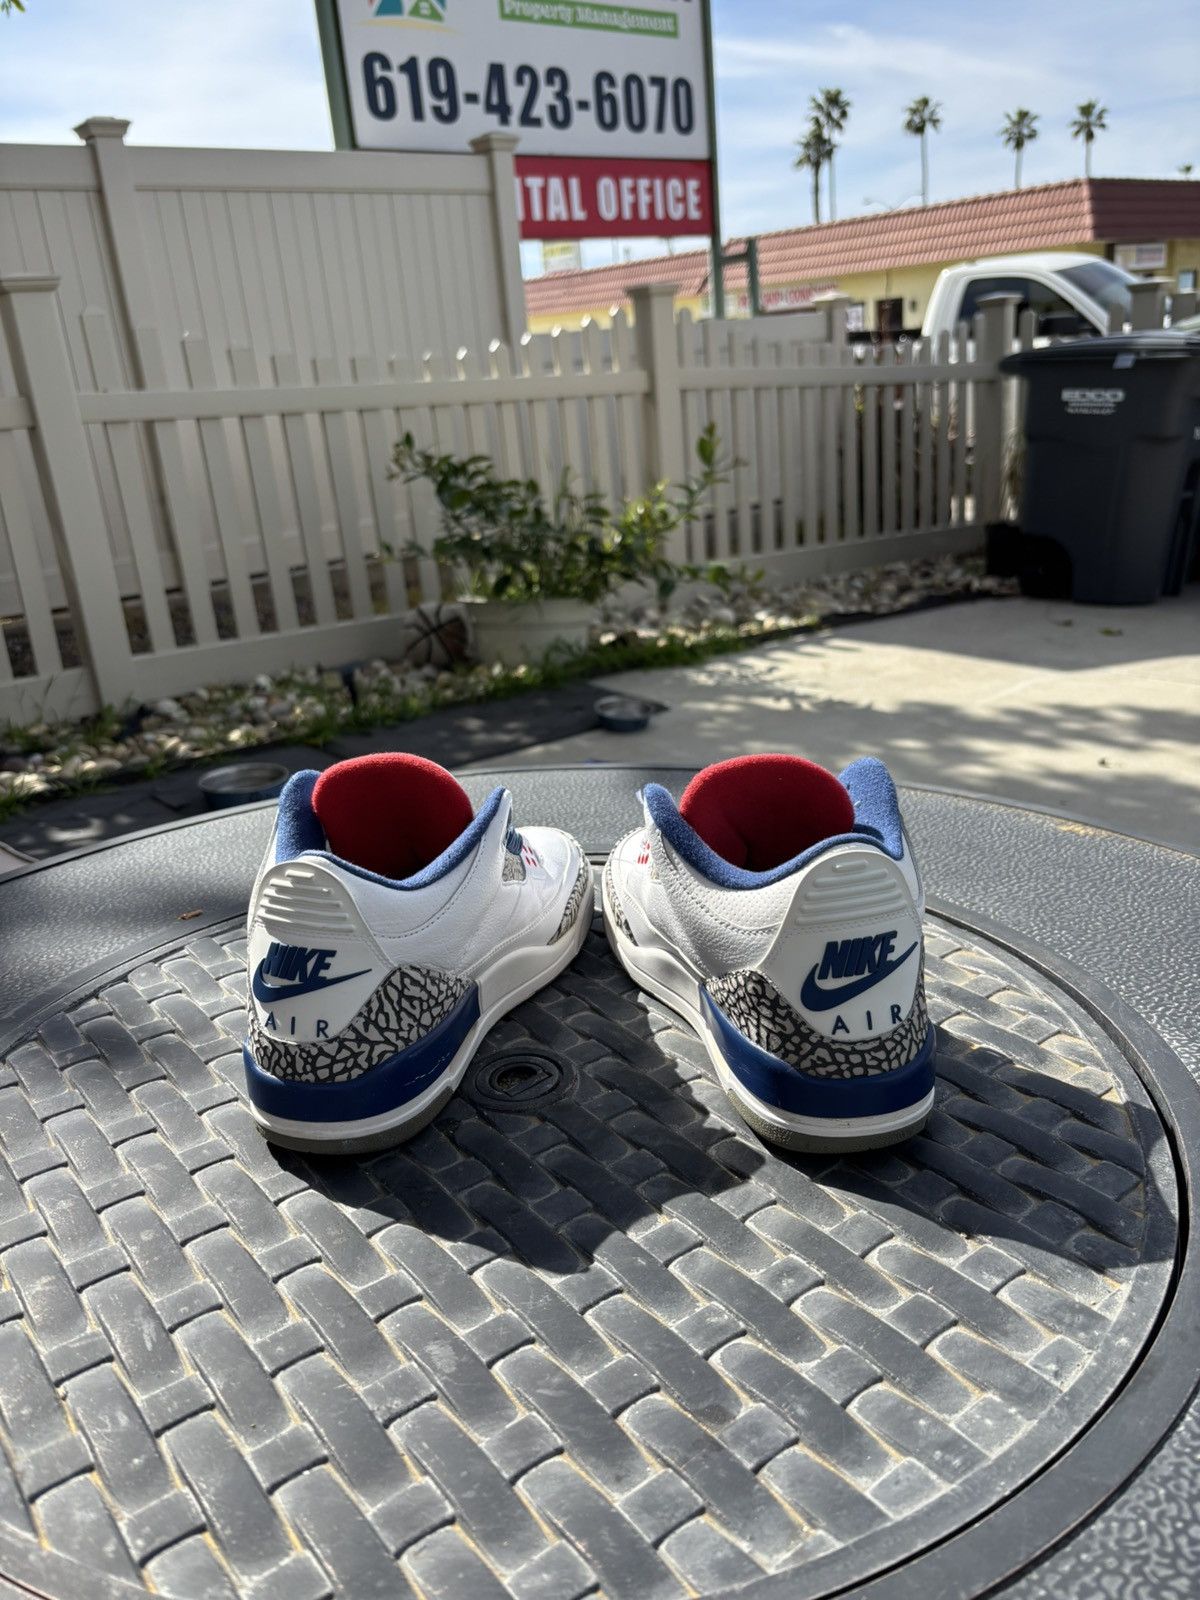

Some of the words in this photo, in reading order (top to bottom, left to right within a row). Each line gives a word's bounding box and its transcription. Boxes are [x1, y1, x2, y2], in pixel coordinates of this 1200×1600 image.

[504, 0, 573, 24] Property
[576, 7, 676, 33] Management
[362, 51, 695, 135] 619-423-6070
[596, 177, 702, 222] OFFICE
[261, 941, 337, 983] NIKE
[817, 930, 898, 980] NIKE
[264, 1011, 330, 1039] AIR
[832, 1003, 903, 1035] AIR
